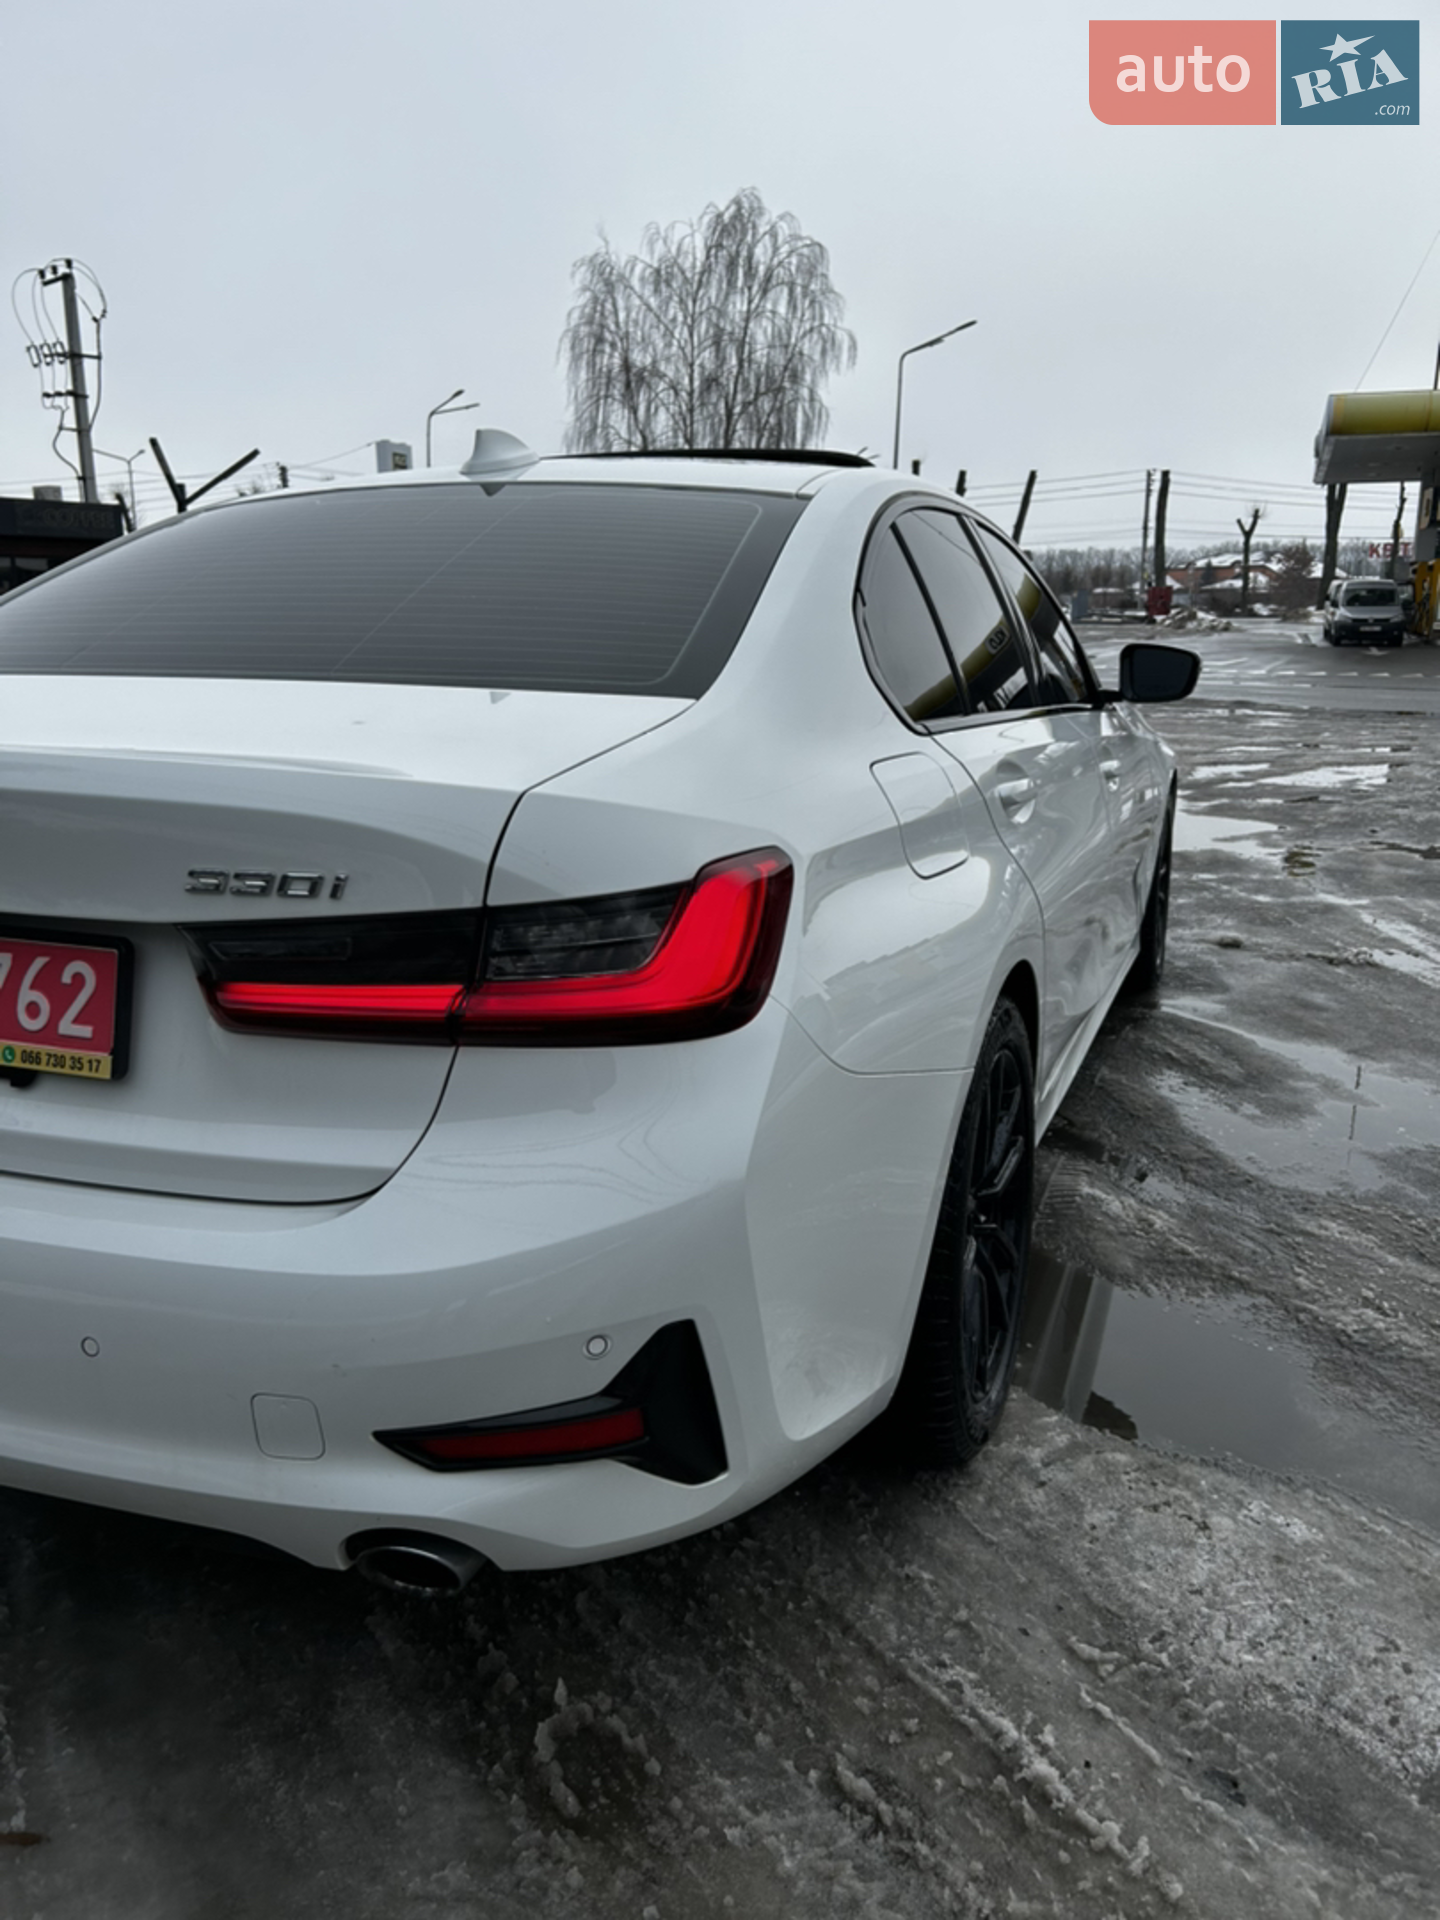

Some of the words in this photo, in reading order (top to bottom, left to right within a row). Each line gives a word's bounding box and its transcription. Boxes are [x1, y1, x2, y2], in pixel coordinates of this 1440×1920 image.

[184, 869, 348, 899] 330i
[21, 1050, 42, 1064] 066
[46, 1053, 66, 1069] 730
[69, 1057, 84, 1071] 35
[88, 1059, 102, 1073] 17
